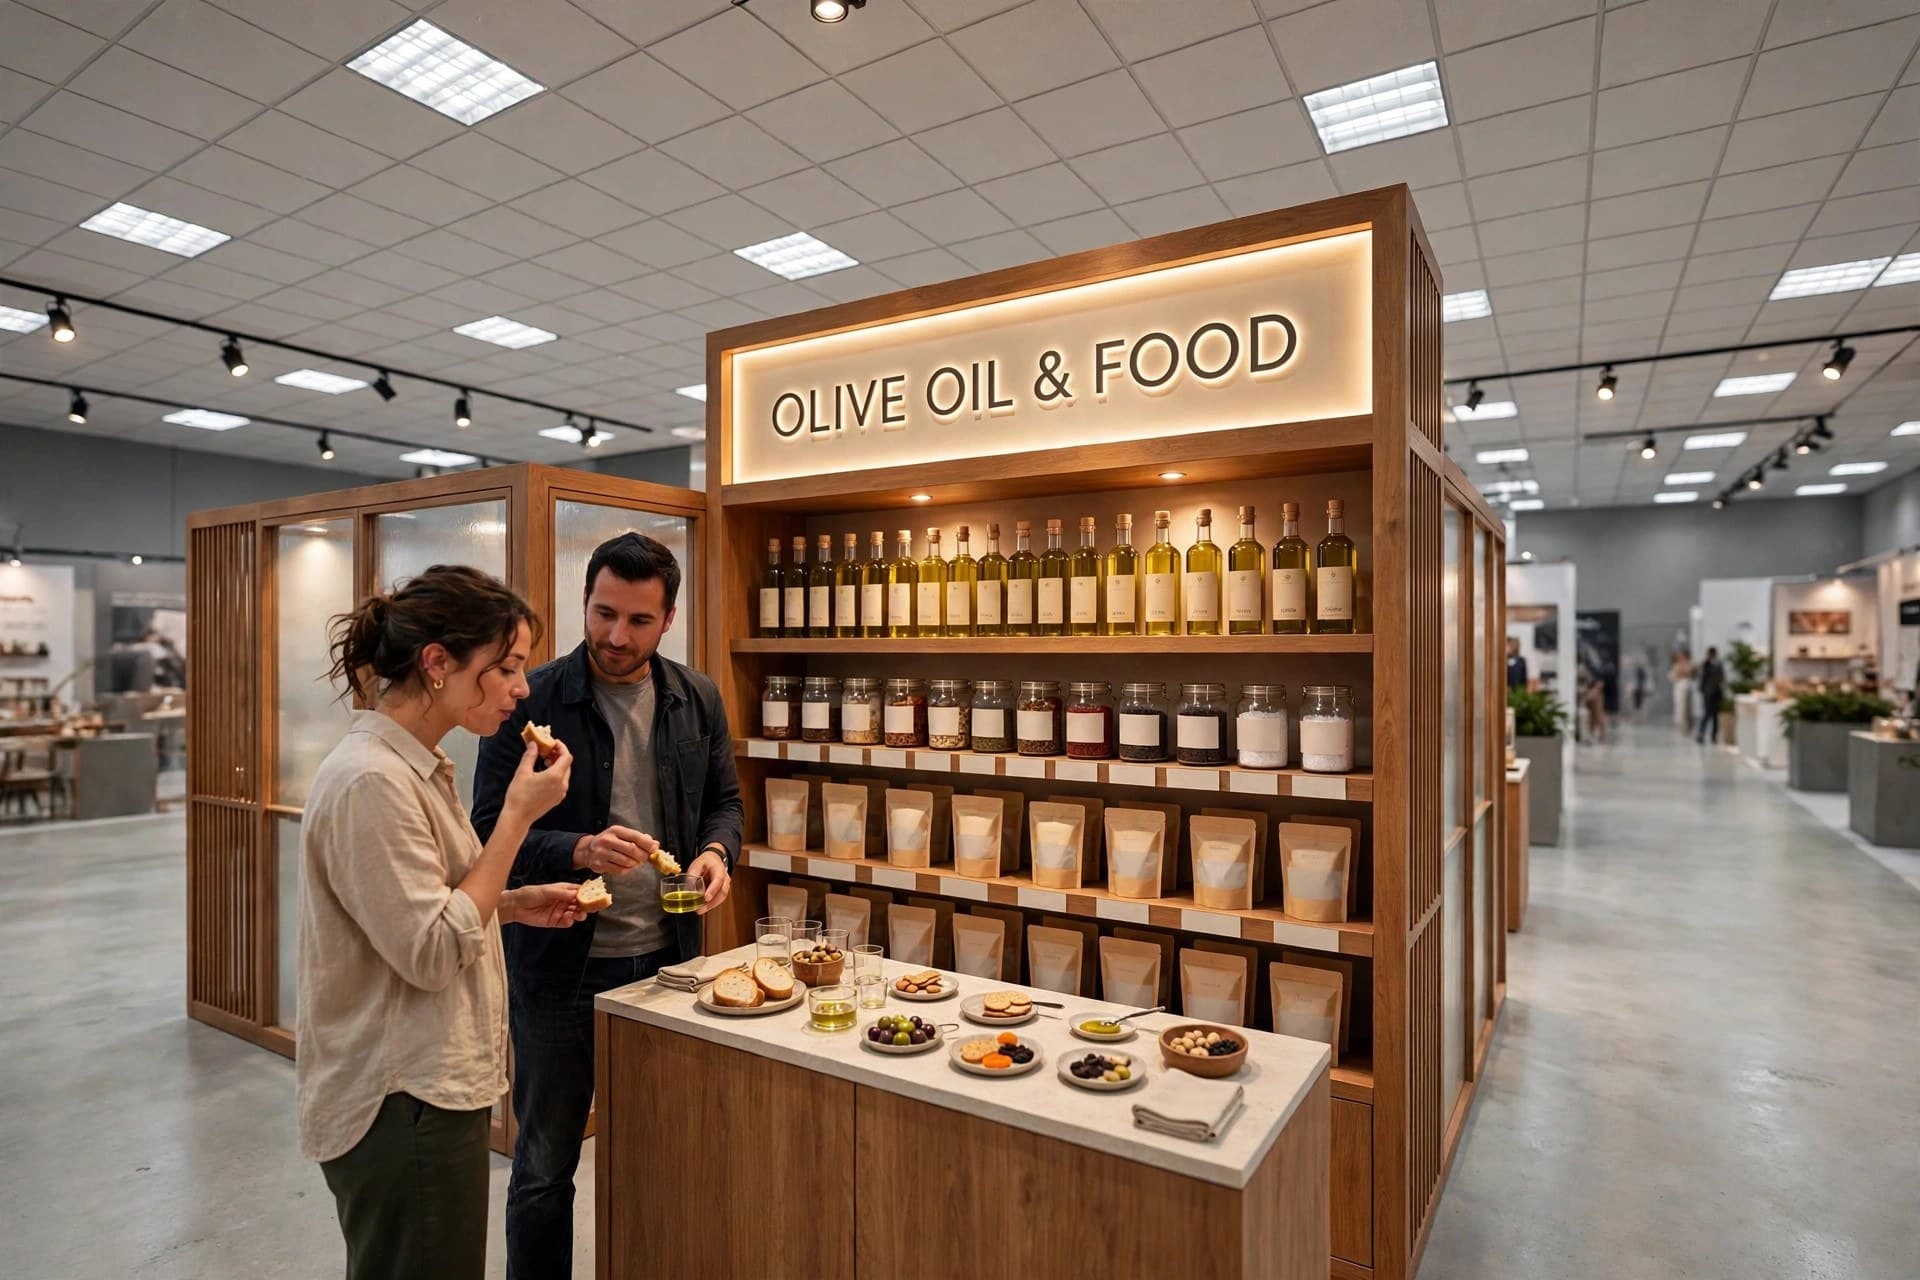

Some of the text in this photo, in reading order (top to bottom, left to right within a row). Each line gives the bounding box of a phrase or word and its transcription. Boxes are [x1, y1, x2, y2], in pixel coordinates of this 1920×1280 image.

[771, 314, 1297, 437] OLIVE OIL & FOOD
